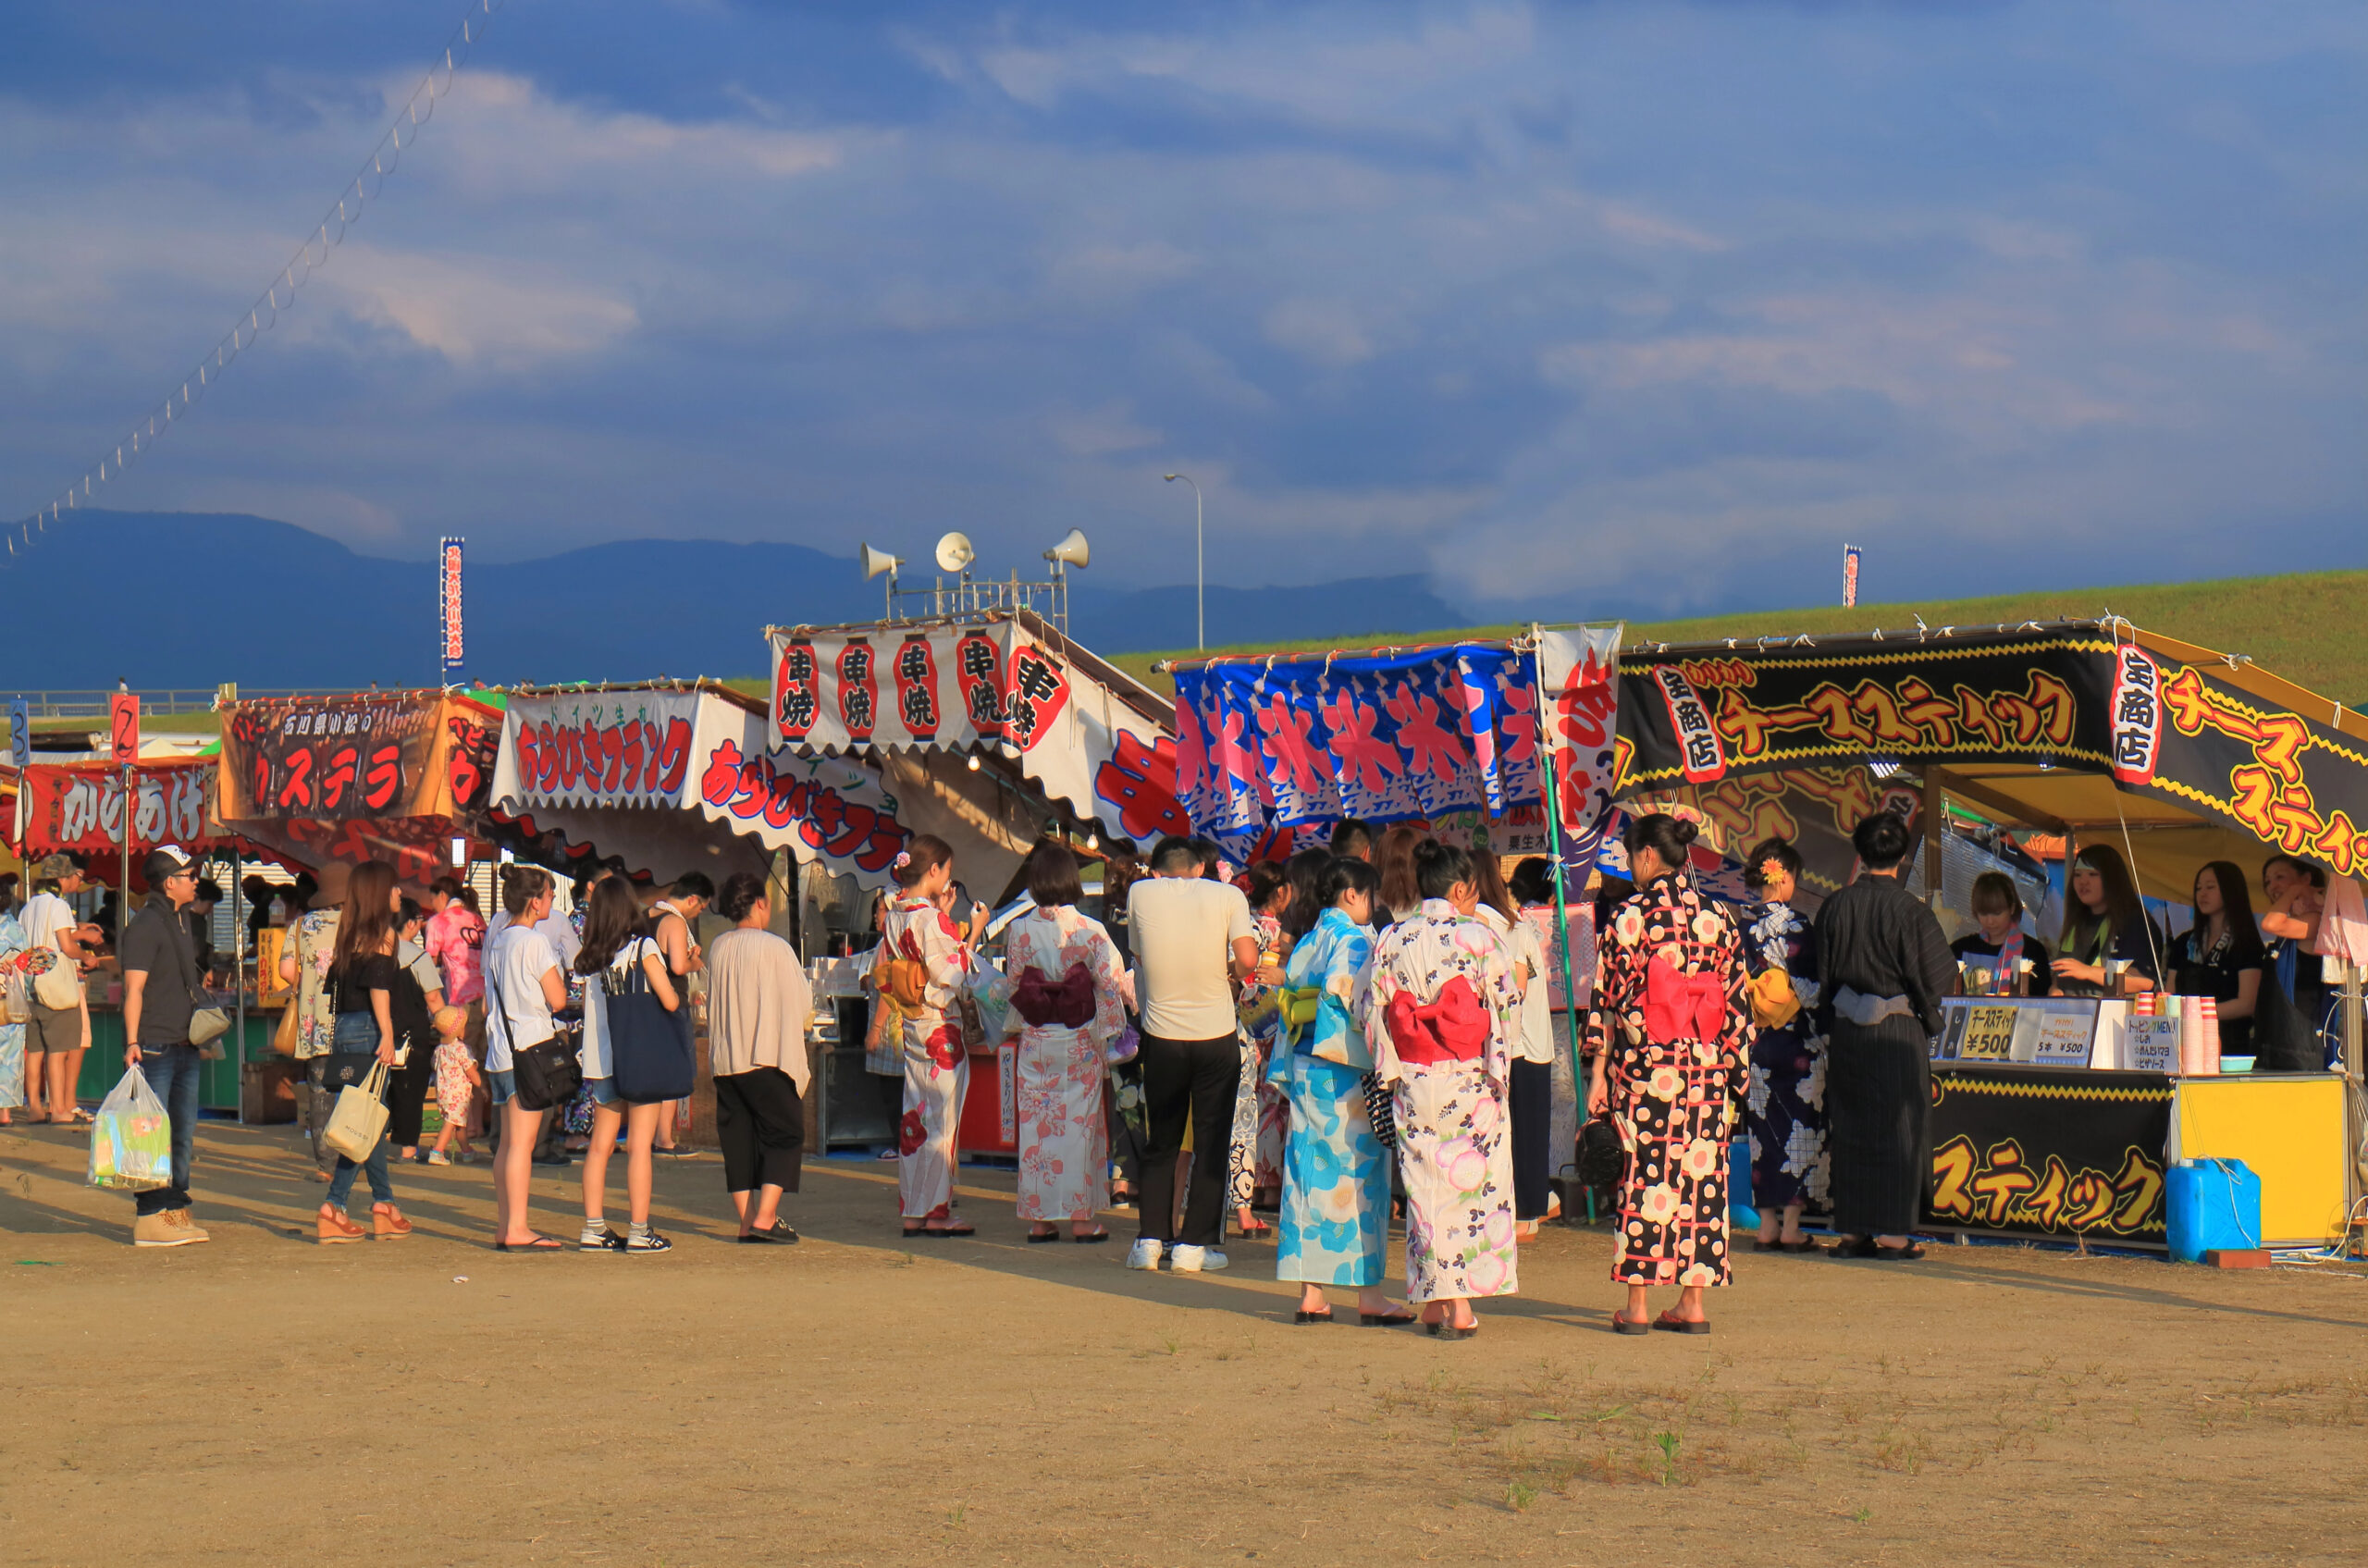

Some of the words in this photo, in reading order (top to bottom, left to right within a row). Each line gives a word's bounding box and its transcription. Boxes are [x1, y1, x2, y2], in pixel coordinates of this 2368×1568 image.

[779, 648, 815, 729] 串焼
[843, 648, 873, 729] 串焼
[900, 645, 936, 727] 串焼
[964, 640, 1003, 724] 串焼
[1003, 653, 1062, 747] 串焼
[1660, 669, 1720, 770] 宝商店
[1716, 670, 2077, 756] チーススティック
[2115, 649, 2156, 769] 宝商店
[13, 711, 26, 757] 3
[117, 708, 134, 752] 2
[1323, 685, 1405, 795] 氷
[1386, 679, 1469, 784] 氷
[61, 769, 204, 845] からあげ
[701, 737, 915, 884] あらびきフラ
[1967, 1032, 2012, 1055] ¥500
[2060, 1043, 2083, 1054] ¥500
